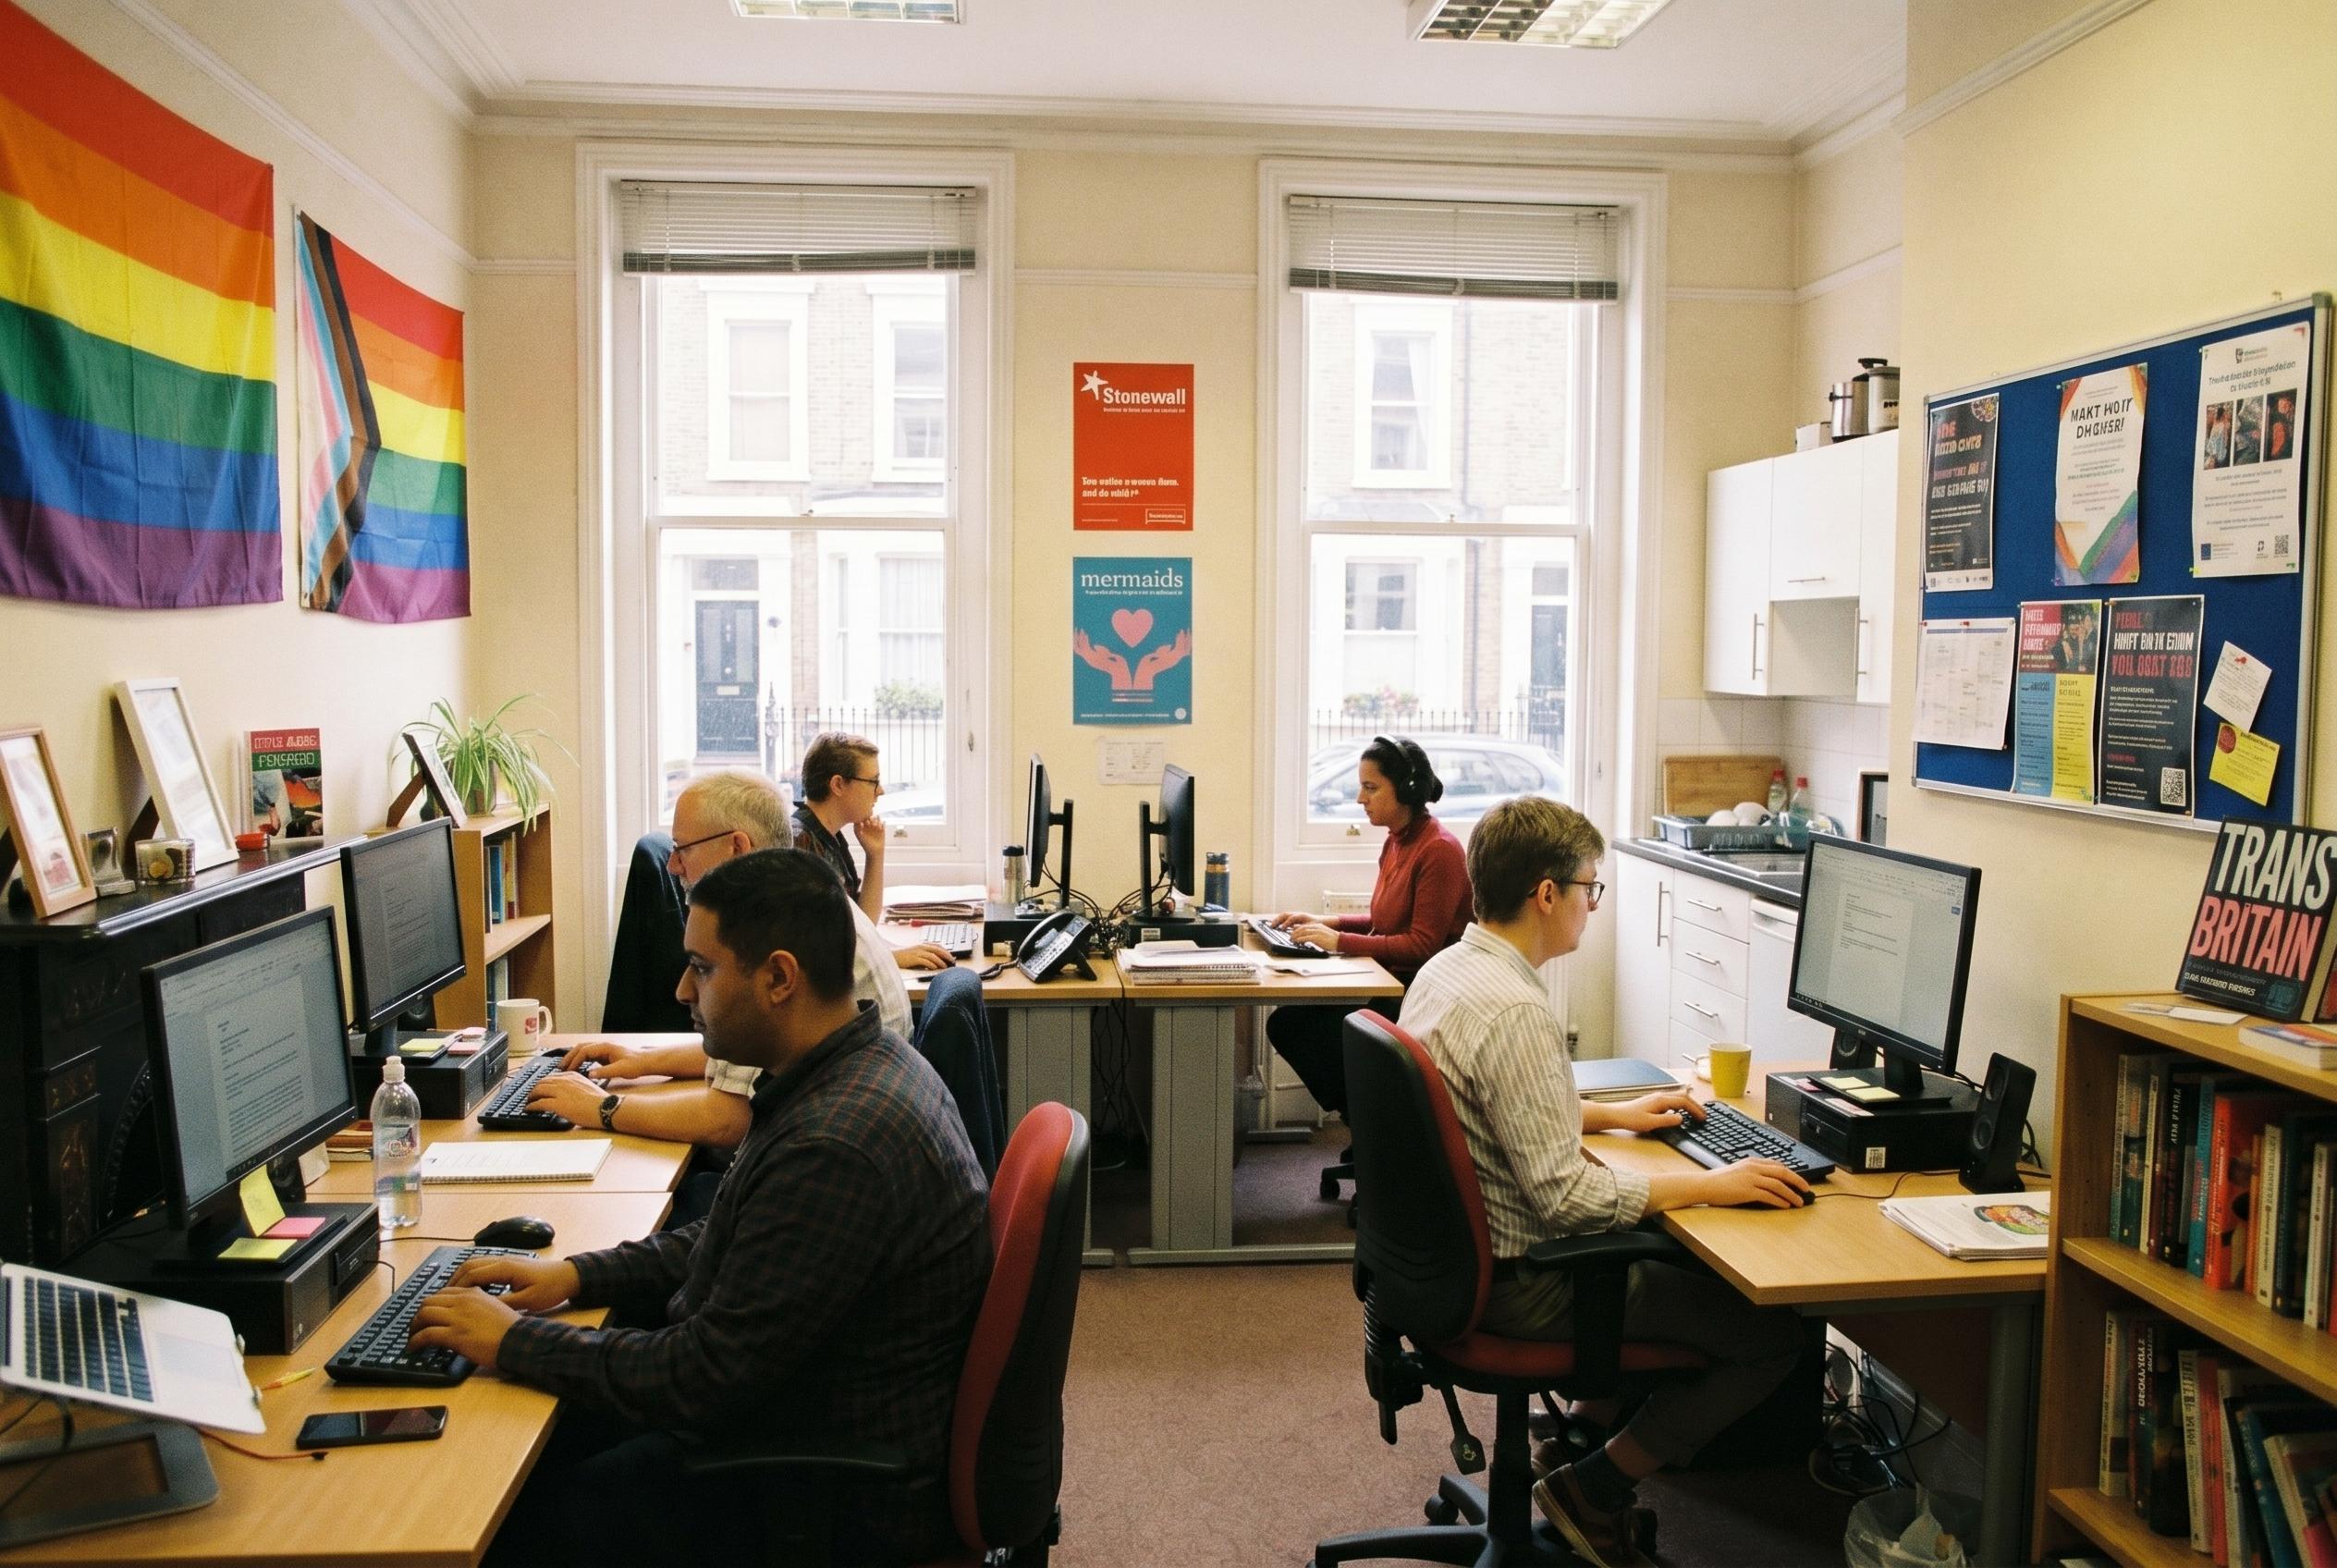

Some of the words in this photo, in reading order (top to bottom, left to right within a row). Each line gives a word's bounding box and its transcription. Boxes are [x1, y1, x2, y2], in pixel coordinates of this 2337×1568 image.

[1103, 388, 1185, 404] Stonewall
[1099, 488, 1109, 497] do
[1081, 568, 1183, 588] mermaids
[2214, 822, 2337, 911] TRANS
[2189, 895, 2322, 982] BRITAIN
